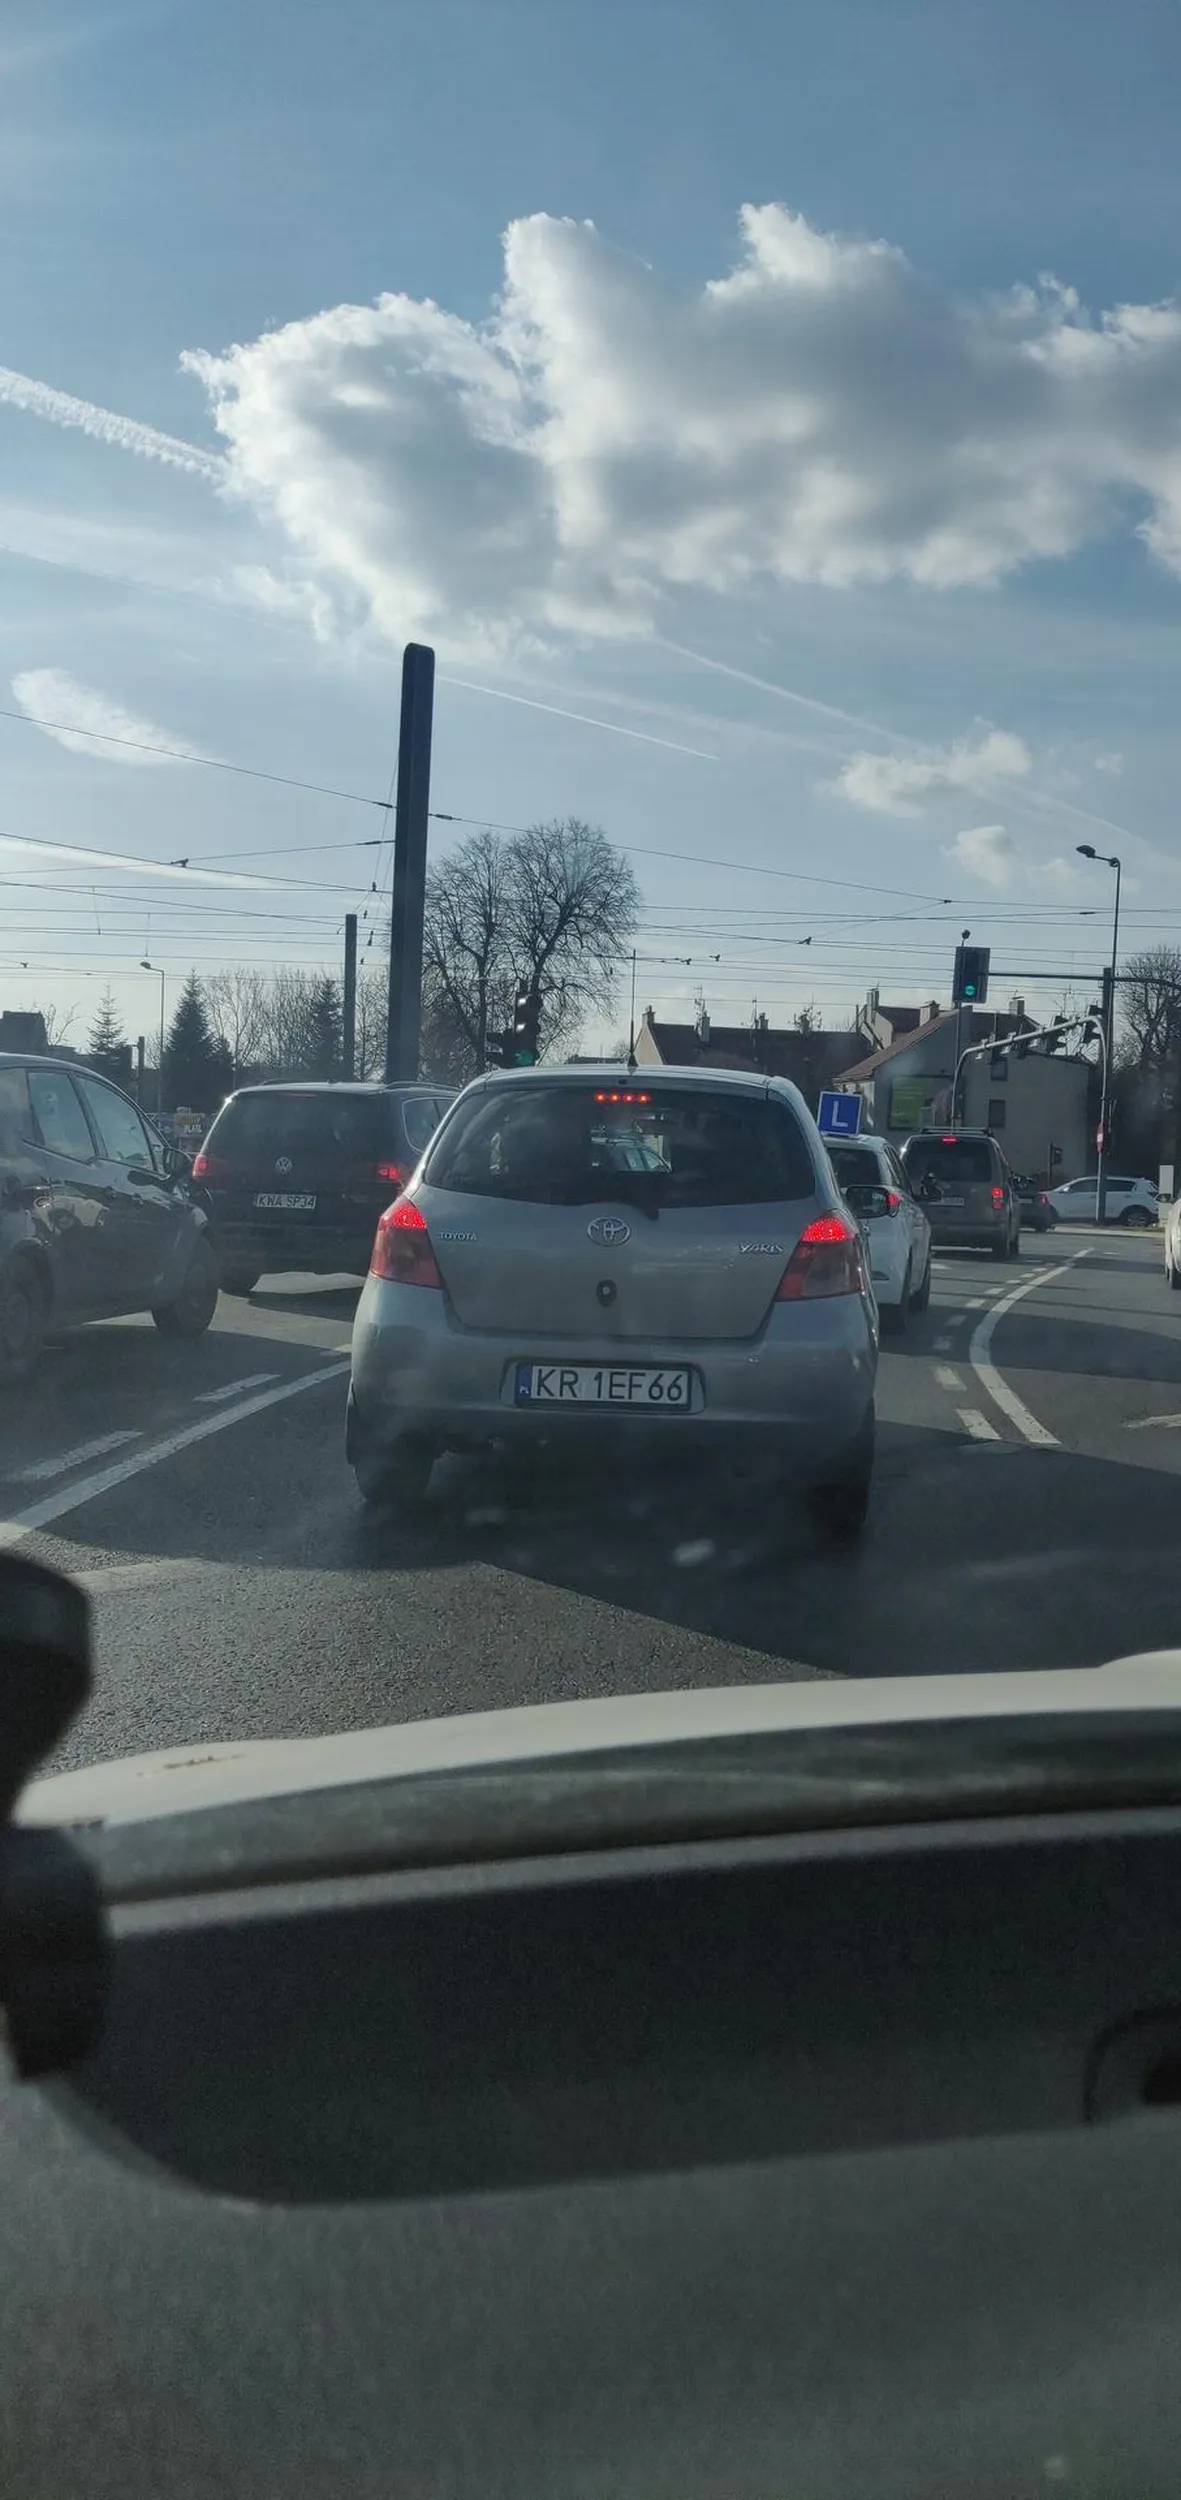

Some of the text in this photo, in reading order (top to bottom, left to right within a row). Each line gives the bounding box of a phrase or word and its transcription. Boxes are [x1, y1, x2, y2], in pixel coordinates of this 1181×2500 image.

[831, 1100, 849, 1128] L
[440, 1231, 477, 1241] TOYOTA
[740, 1242, 783, 1252] YARIS
[536, 1368, 683, 1402] KR 1EF66
